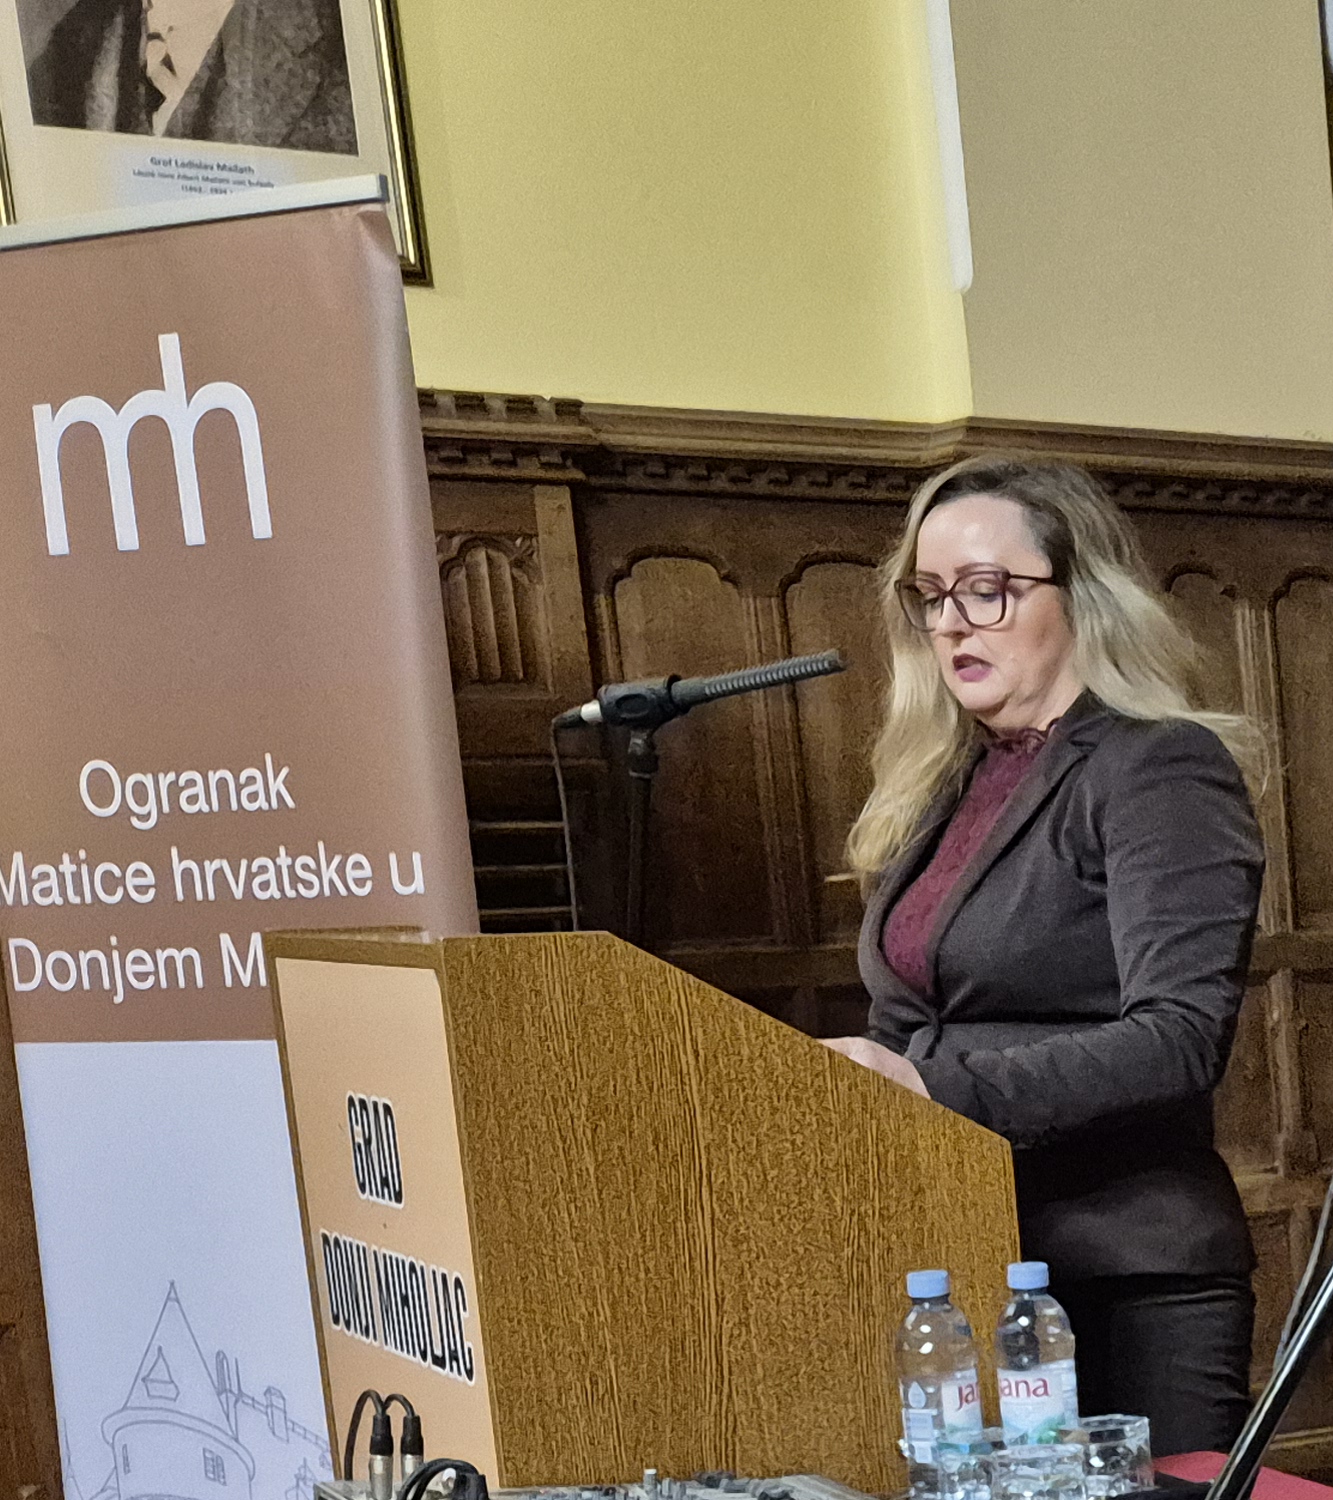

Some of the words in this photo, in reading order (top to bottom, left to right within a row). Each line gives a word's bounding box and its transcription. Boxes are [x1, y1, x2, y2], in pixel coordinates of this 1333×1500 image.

[79, 752, 296, 830] Ogranak
[0, 848, 157, 907] Matice
[170, 840, 374, 902] hrvatske
[388, 851, 426, 896] u
[8, 934, 205, 1005] Donjem
[347, 1093, 404, 1206] GRAD
[320, 1231, 378, 1344] DONJI
[372, 1247, 475, 1383] MIHOLJAC
[1000, 1376, 1050, 1399] ana
